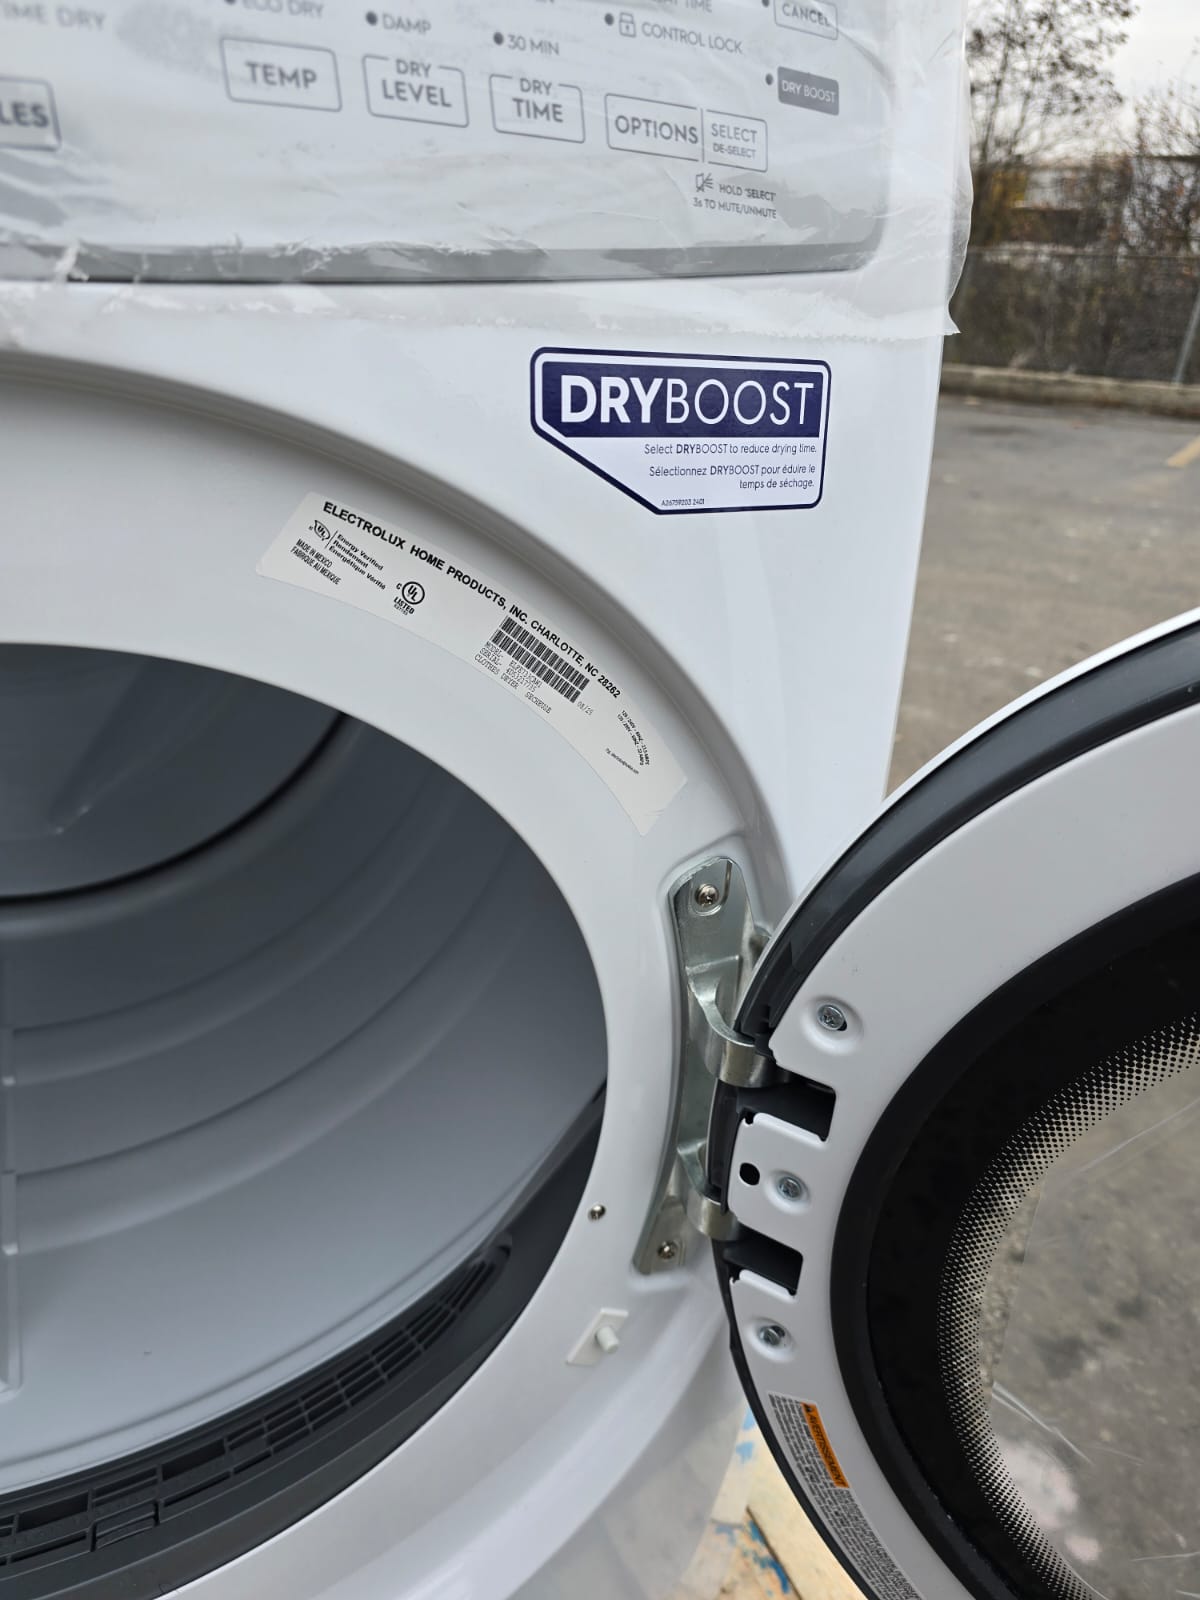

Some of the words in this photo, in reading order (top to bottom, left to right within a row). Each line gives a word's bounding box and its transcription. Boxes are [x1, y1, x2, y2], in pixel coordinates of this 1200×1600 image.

[287, 0, 323, 18] DRY
[782, 2, 830, 27] CANCEL
[382, 13, 432, 35] DAMP
[508, 34, 526, 51] 30
[530, 38, 560, 56] MIN
[641, 21, 704, 46] CONTROL
[708, 37, 743, 55] LOCK
[246, 61, 317, 89] TEMP
[396, 58, 432, 78] DRY
[382, 79, 452, 107] LEVEL
[519, 77, 552, 97] DRY
[782, 80, 801, 95] DRY
[804, 85, 835, 103] BOOST
[512, 98, 563, 123] TIME
[614, 115, 698, 145] OPTIONS
[711, 123, 757, 144] SELECT
[713, 142, 756, 160] DE-SELECT
[719, 183, 743, 197] HOLD
[704, 198, 717, 210] TO
[718, 201, 777, 219] MUTE/UNMUTE
[560, 374, 814, 426] DRYBOOST
[644, 443, 673, 455] Select
[676, 443, 728, 455] DRYBOOST
[729, 444, 738, 454] to
[740, 443, 769, 454] reduce
[771, 443, 797, 456] drying
[799, 442, 816, 454] time.
[649, 465, 707, 477] Sélectionnez
[710, 464, 759, 476] DRYBOOST
[760, 466, 780, 476] pour
[808, 463, 816, 474] le
[739, 479, 765, 491] temps
[766, 478, 777, 488] de
[295, 538, 312, 554] MADE
[313, 551, 333, 569] MEXICO
[333, 540, 369, 569] Rendement
[337, 534, 360, 553] Energy
[360, 549, 384, 571] Verified
[319, 566, 342, 585] MEXIQUE
[323, 501, 407, 550] ELECTROLUX
[410, 544, 445, 571] HOME
[446, 565, 507, 610] PRODUCTS,
[509, 604, 528, 624] INC.
[530, 620, 584, 667] CHARLOTTE,
[584, 662, 599, 677] NC
[597, 674, 621, 699] 28262
[393, 596, 415, 615] LISTED
[474, 653, 500, 675] CLOTHES
